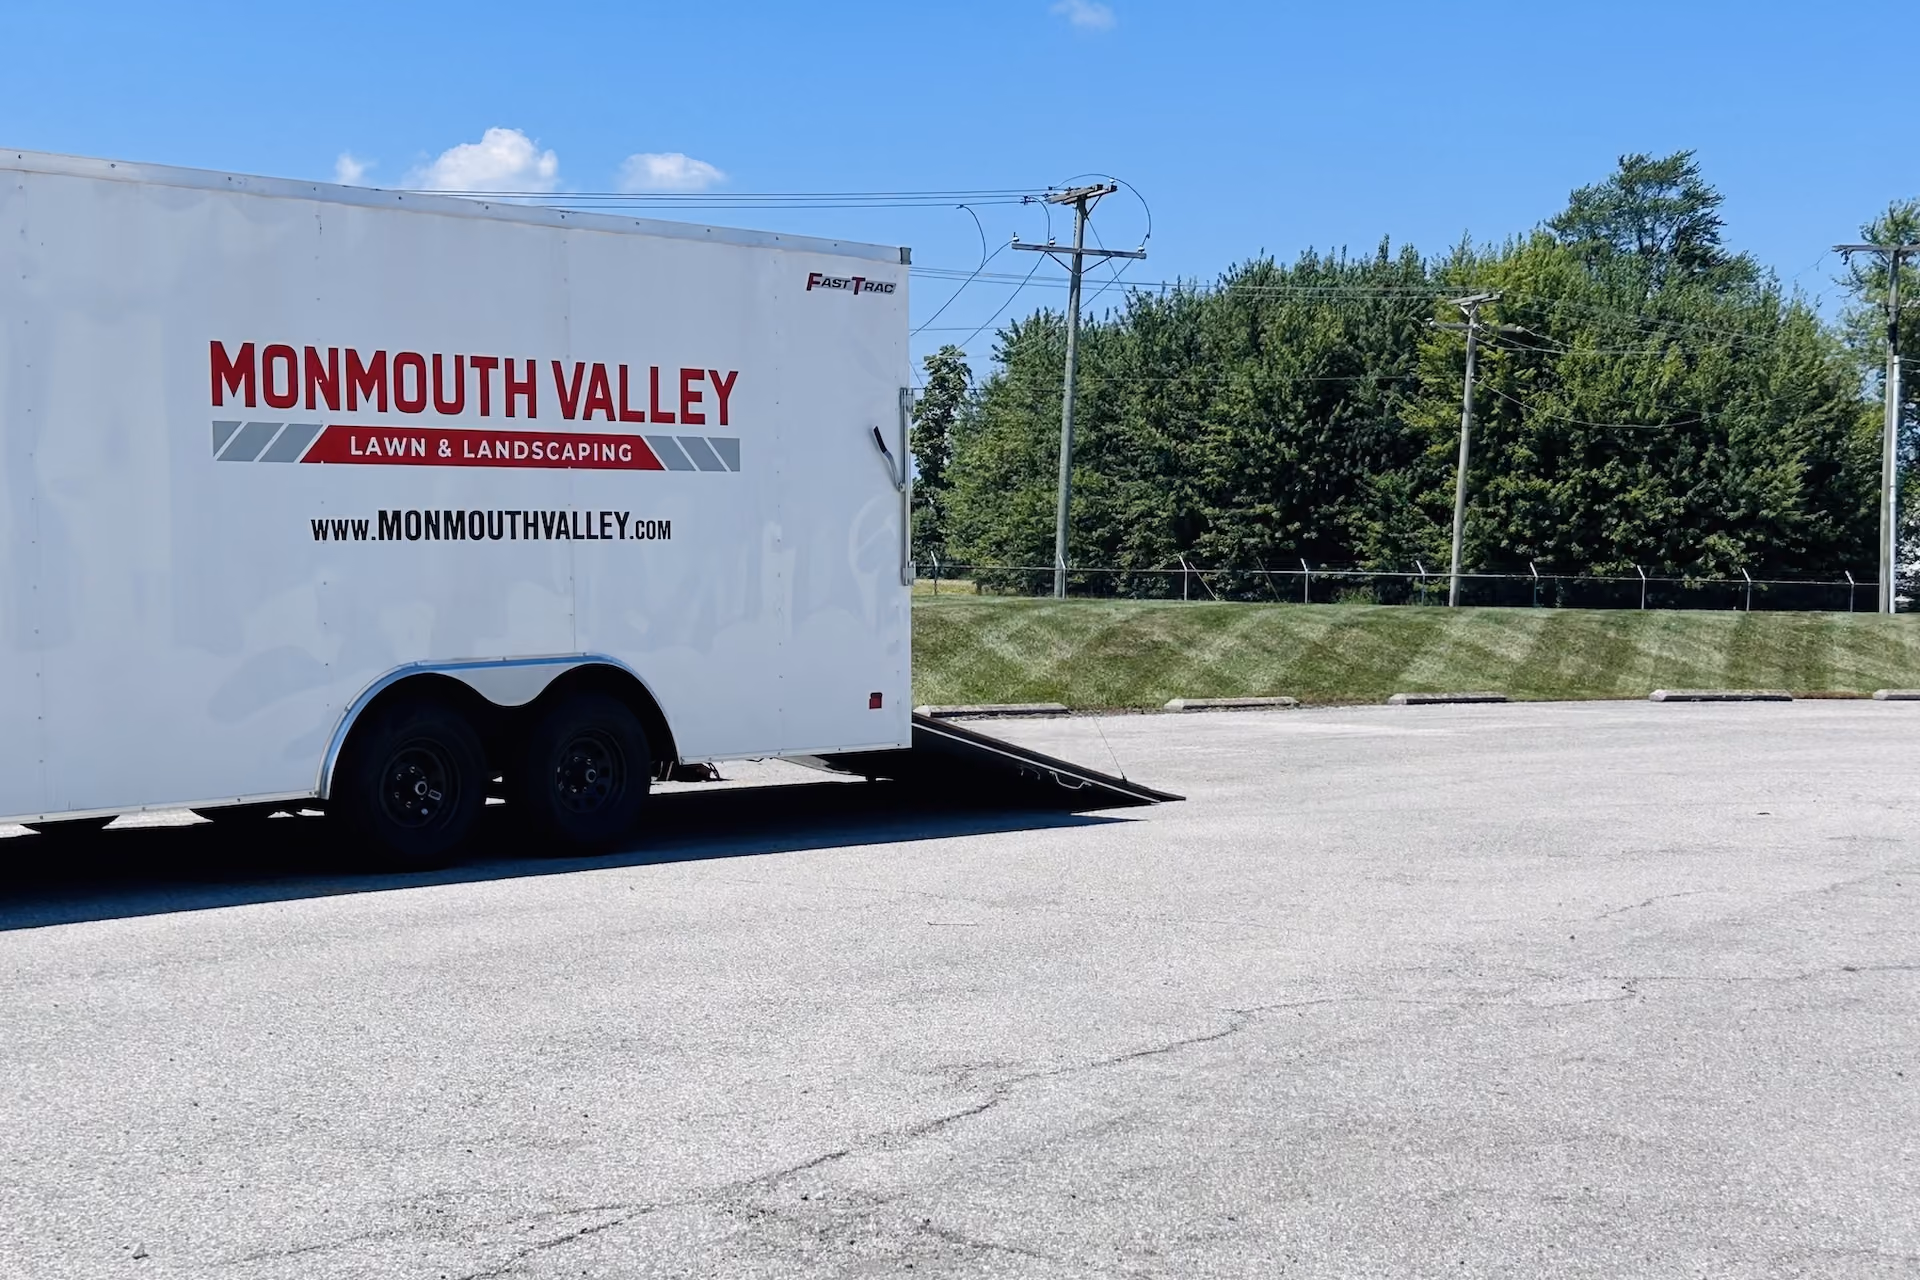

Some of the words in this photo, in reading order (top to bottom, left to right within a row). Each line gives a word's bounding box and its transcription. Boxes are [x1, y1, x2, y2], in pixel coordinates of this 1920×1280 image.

[210, 341, 537, 418] MONMOUTH
[552, 361, 737, 425] VALLEY
[349, 435, 427, 457] LAWN
[437, 438, 453, 458] &
[463, 439, 633, 462] LANDSCAPING
